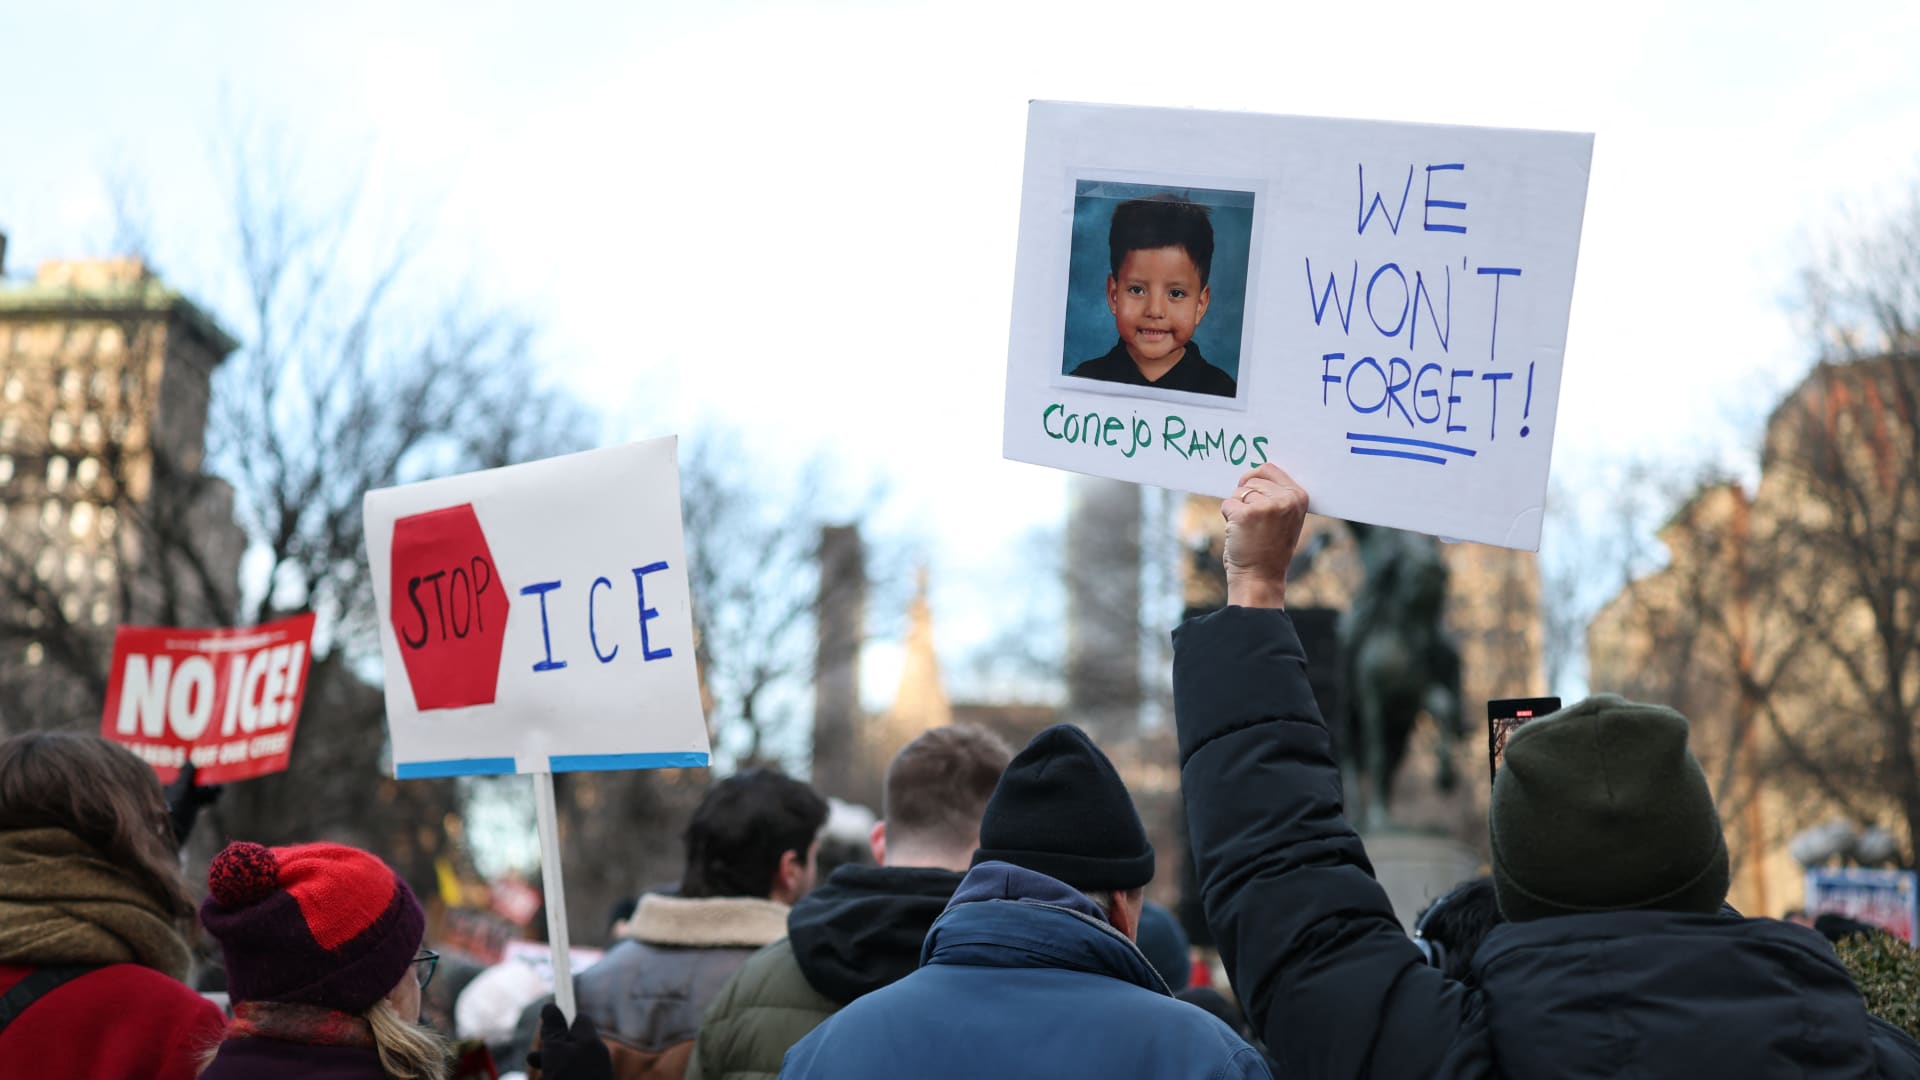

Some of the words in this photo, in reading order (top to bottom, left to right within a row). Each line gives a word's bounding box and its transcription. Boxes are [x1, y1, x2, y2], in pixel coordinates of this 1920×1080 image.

[1358, 163, 1467, 235] WE
[1305, 256, 1522, 361] WON'T
[1043, 403, 1152, 458] Conejo
[1162, 415, 1269, 468] RAMOS
[1322, 353, 1535, 441] FORGET!
[402, 556, 490, 649] STOP
[520, 561, 673, 672] ICE
[116, 653, 216, 741] NO
[220, 641, 306, 736] ICE!
[121, 741, 186, 768] ANDS
